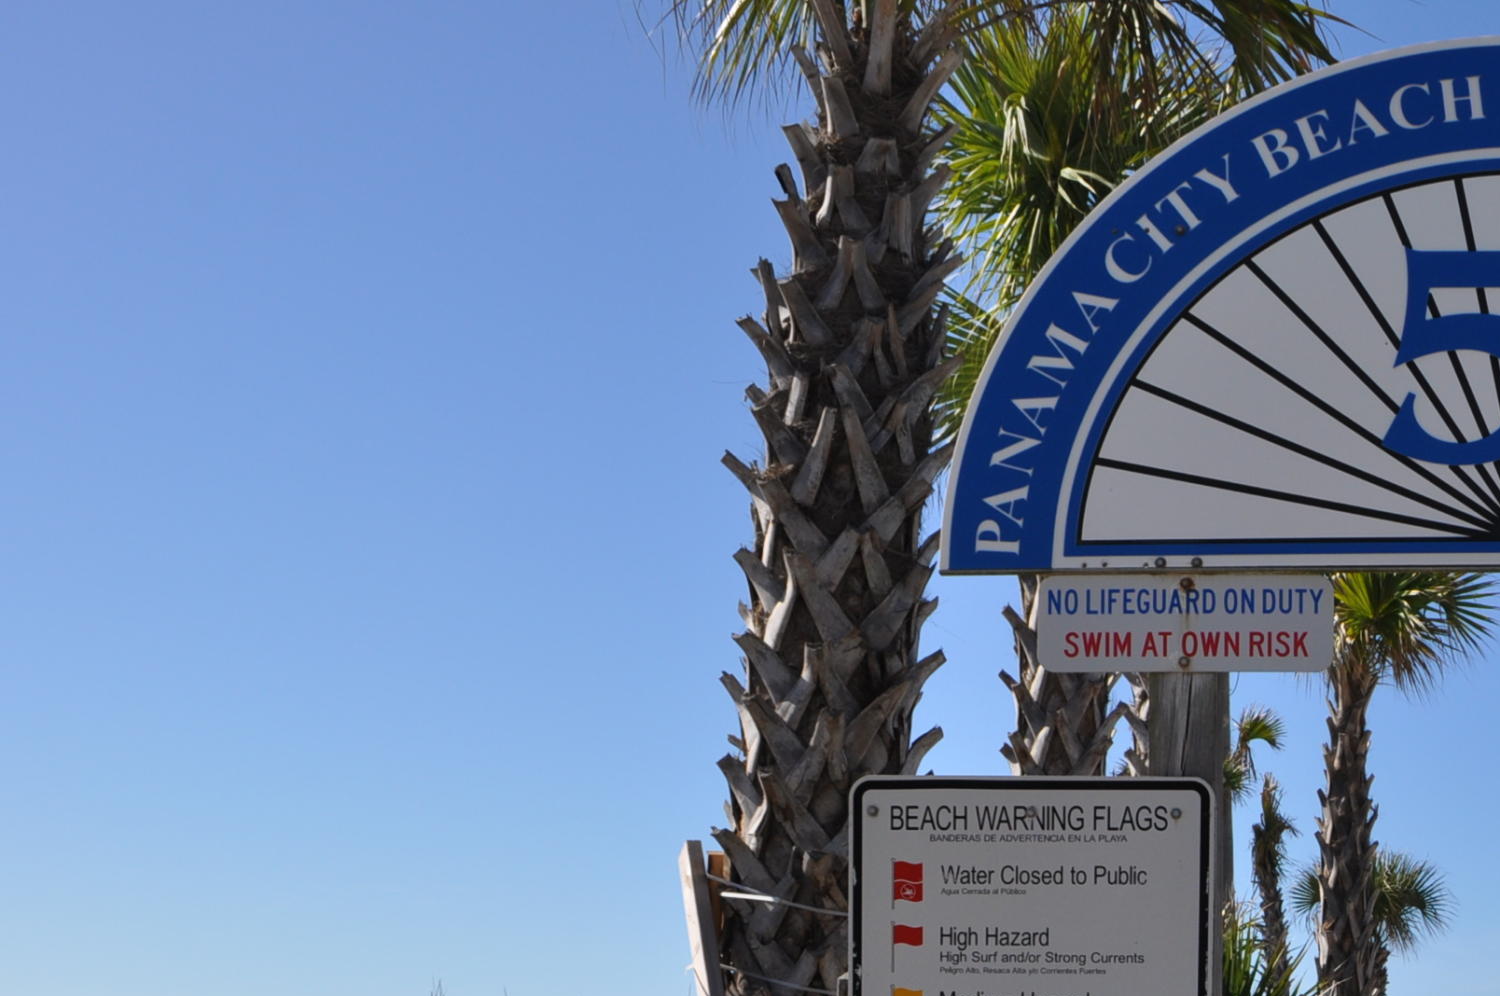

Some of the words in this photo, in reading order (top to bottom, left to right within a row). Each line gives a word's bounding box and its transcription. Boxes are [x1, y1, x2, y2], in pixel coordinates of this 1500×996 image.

[975, 289, 1120, 556] PANAMA
[1104, 153, 1241, 283] CITY
[1250, 76, 1486, 179] BEACH
[1047, 588, 1079, 615] NO
[1086, 588, 1216, 615] LIFEGUARD
[1224, 588, 1255, 615] ON
[1262, 588, 1323, 615] DUTY
[1063, 631, 1132, 658] SWIM
[1141, 631, 1173, 658] AT
[1181, 631, 1240, 658] OWN
[1249, 631, 1308, 658] RISK
[890, 805, 968, 831] BEACH
[975, 805, 1084, 831] WARNING
[1093, 805, 1168, 831] FLAGS
[929, 834, 981, 842] BANDERAS
[984, 834, 996, 842] DE
[999, 834, 1066, 843] ADVERTENCIA
[1068, 834, 1081, 842] EN
[1083, 834, 1096, 843] LA
[1098, 834, 1128, 843] PLAYA
[941, 865, 995, 885] Water
[1000, 865, 1064, 885] Closed
[1070, 866, 1087, 885] to
[1094, 865, 1147, 885] Public
[940, 926, 978, 952] High
[985, 927, 1049, 947] Hazard
[939, 951, 967, 966] High
[971, 951, 998, 963] Surf
[1001, 951, 1041, 963] and/or
[1045, 951, 1087, 966] Strong
[1090, 952, 1145, 964] Currents
